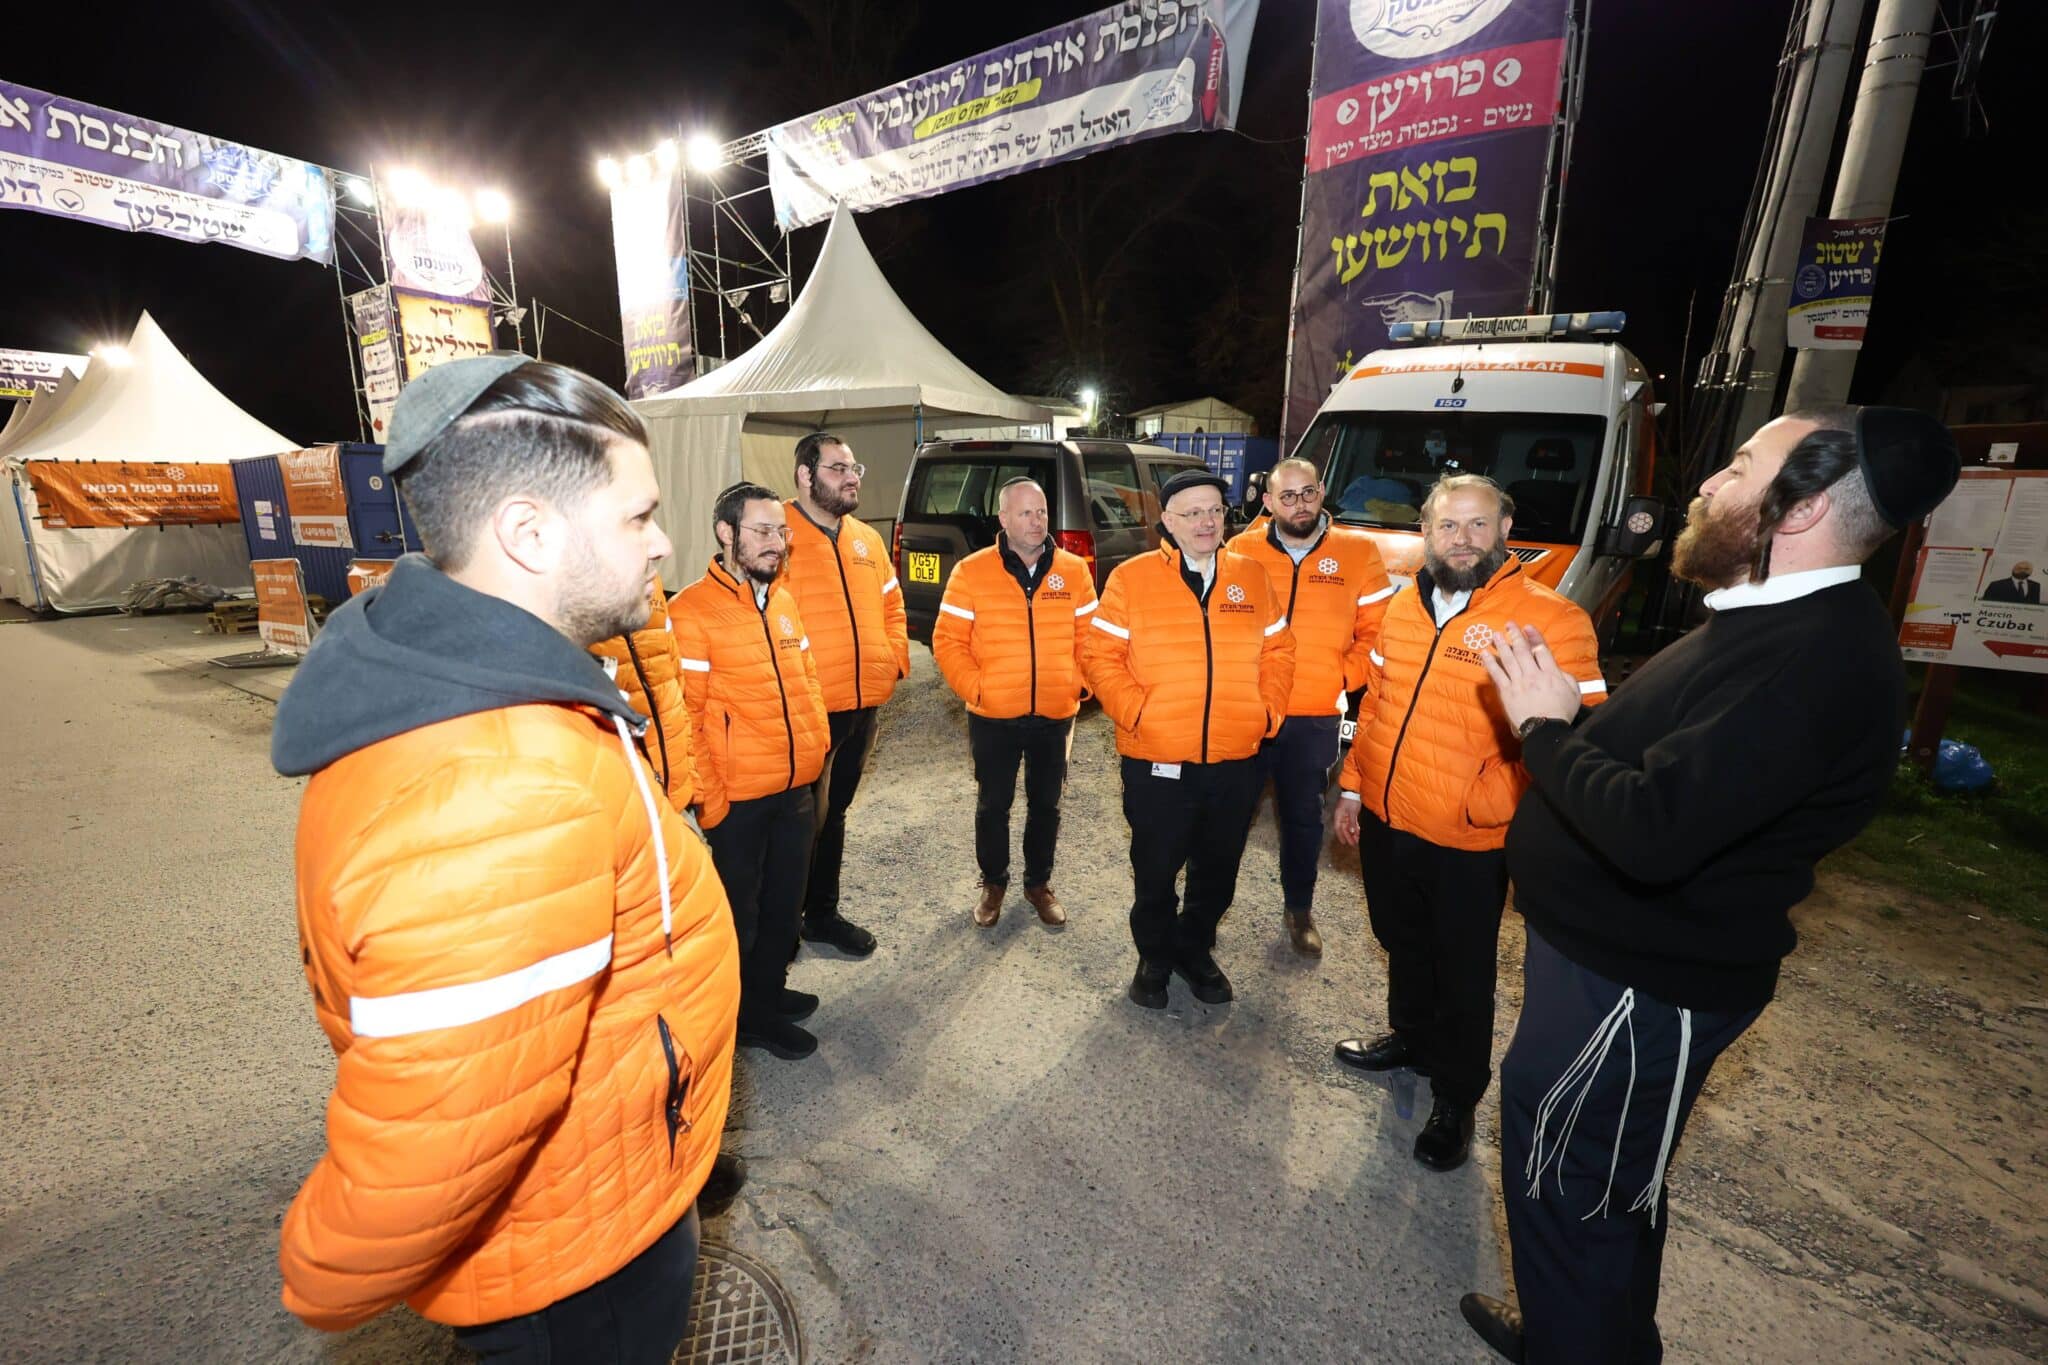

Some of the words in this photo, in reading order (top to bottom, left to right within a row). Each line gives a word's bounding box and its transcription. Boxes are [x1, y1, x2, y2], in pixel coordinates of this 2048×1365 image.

[1094, 0, 1207, 63] הכנסת
[984, 31, 1086, 97] אורחים
[1367, 58, 1485, 133] פרויען
[1080, 109, 1131, 141] האהל
[1397, 114, 1458, 142] נכנסות
[1483, 102, 1533, 127] נשים
[46, 105, 182, 169] הכנסת
[1015, 134, 1042, 157] של
[1359, 131, 1394, 152] מצד
[1325, 142, 1355, 168] ימין
[1362, 157, 1478, 218] בזאת
[114, 199, 246, 238] שטיבלעך
[1331, 212, 1508, 285] תיוושעו
[1815, 241, 1865, 265] שטוב
[912, 553, 938, 570] YG57
[1976, 617, 2035, 632] Czubat
[1978, 609, 2013, 619] Marcin
